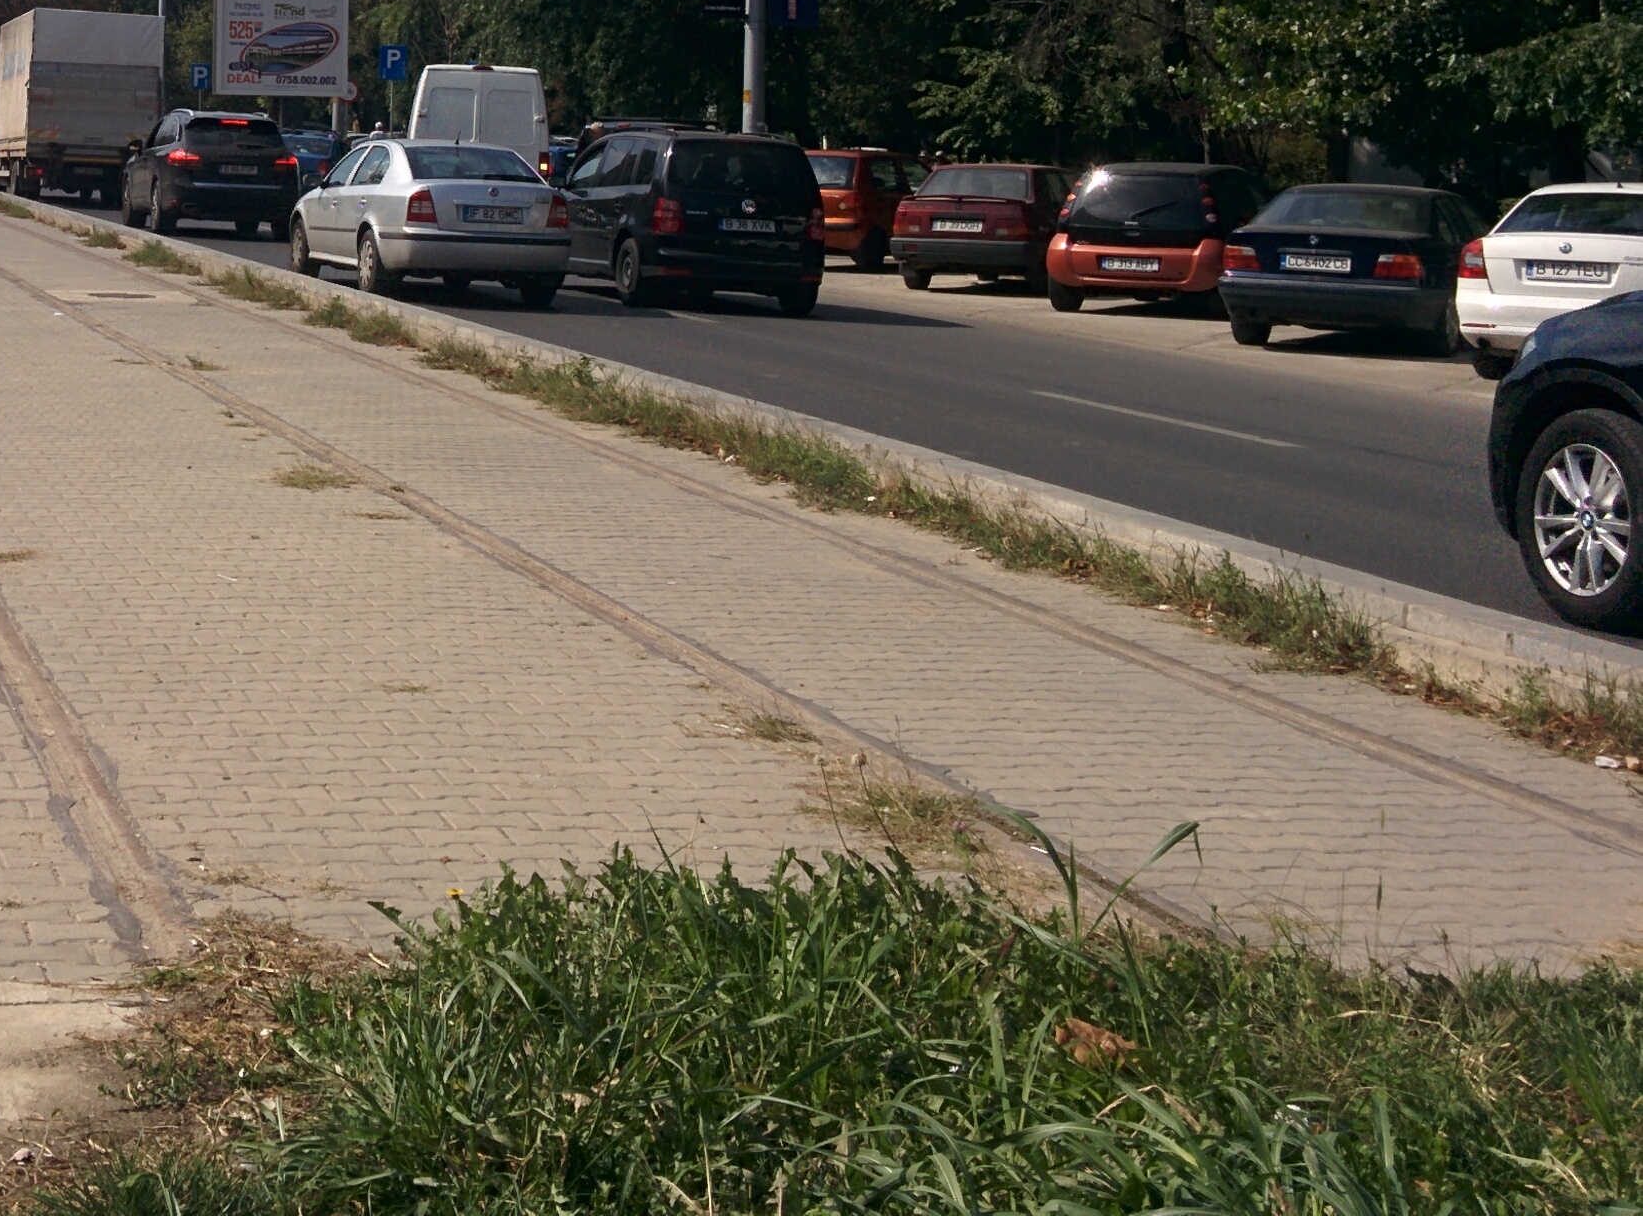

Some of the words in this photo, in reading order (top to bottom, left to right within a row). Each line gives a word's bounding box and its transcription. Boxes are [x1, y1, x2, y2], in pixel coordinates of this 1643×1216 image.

[229, 20, 253, 39] 525
[387, 49, 401, 69] P
[193, 66, 208, 87] P
[275, 75, 337, 86] 0758.002.002
[470, 208, 480, 219] IF
[483, 209, 495, 220] 82
[498, 210, 519, 221] GMC
[725, 219, 733, 229] B
[751, 220, 772, 231] XVK
[1107, 258, 1115, 268] B
[1287, 256, 1302, 267] CC
[1304, 257, 1331, 269] 6402
[1333, 258, 1348, 270] CB
[1536, 263, 1546, 275] B
[1551, 263, 1571, 276] 127
[1575, 263, 1604, 278] TEU
